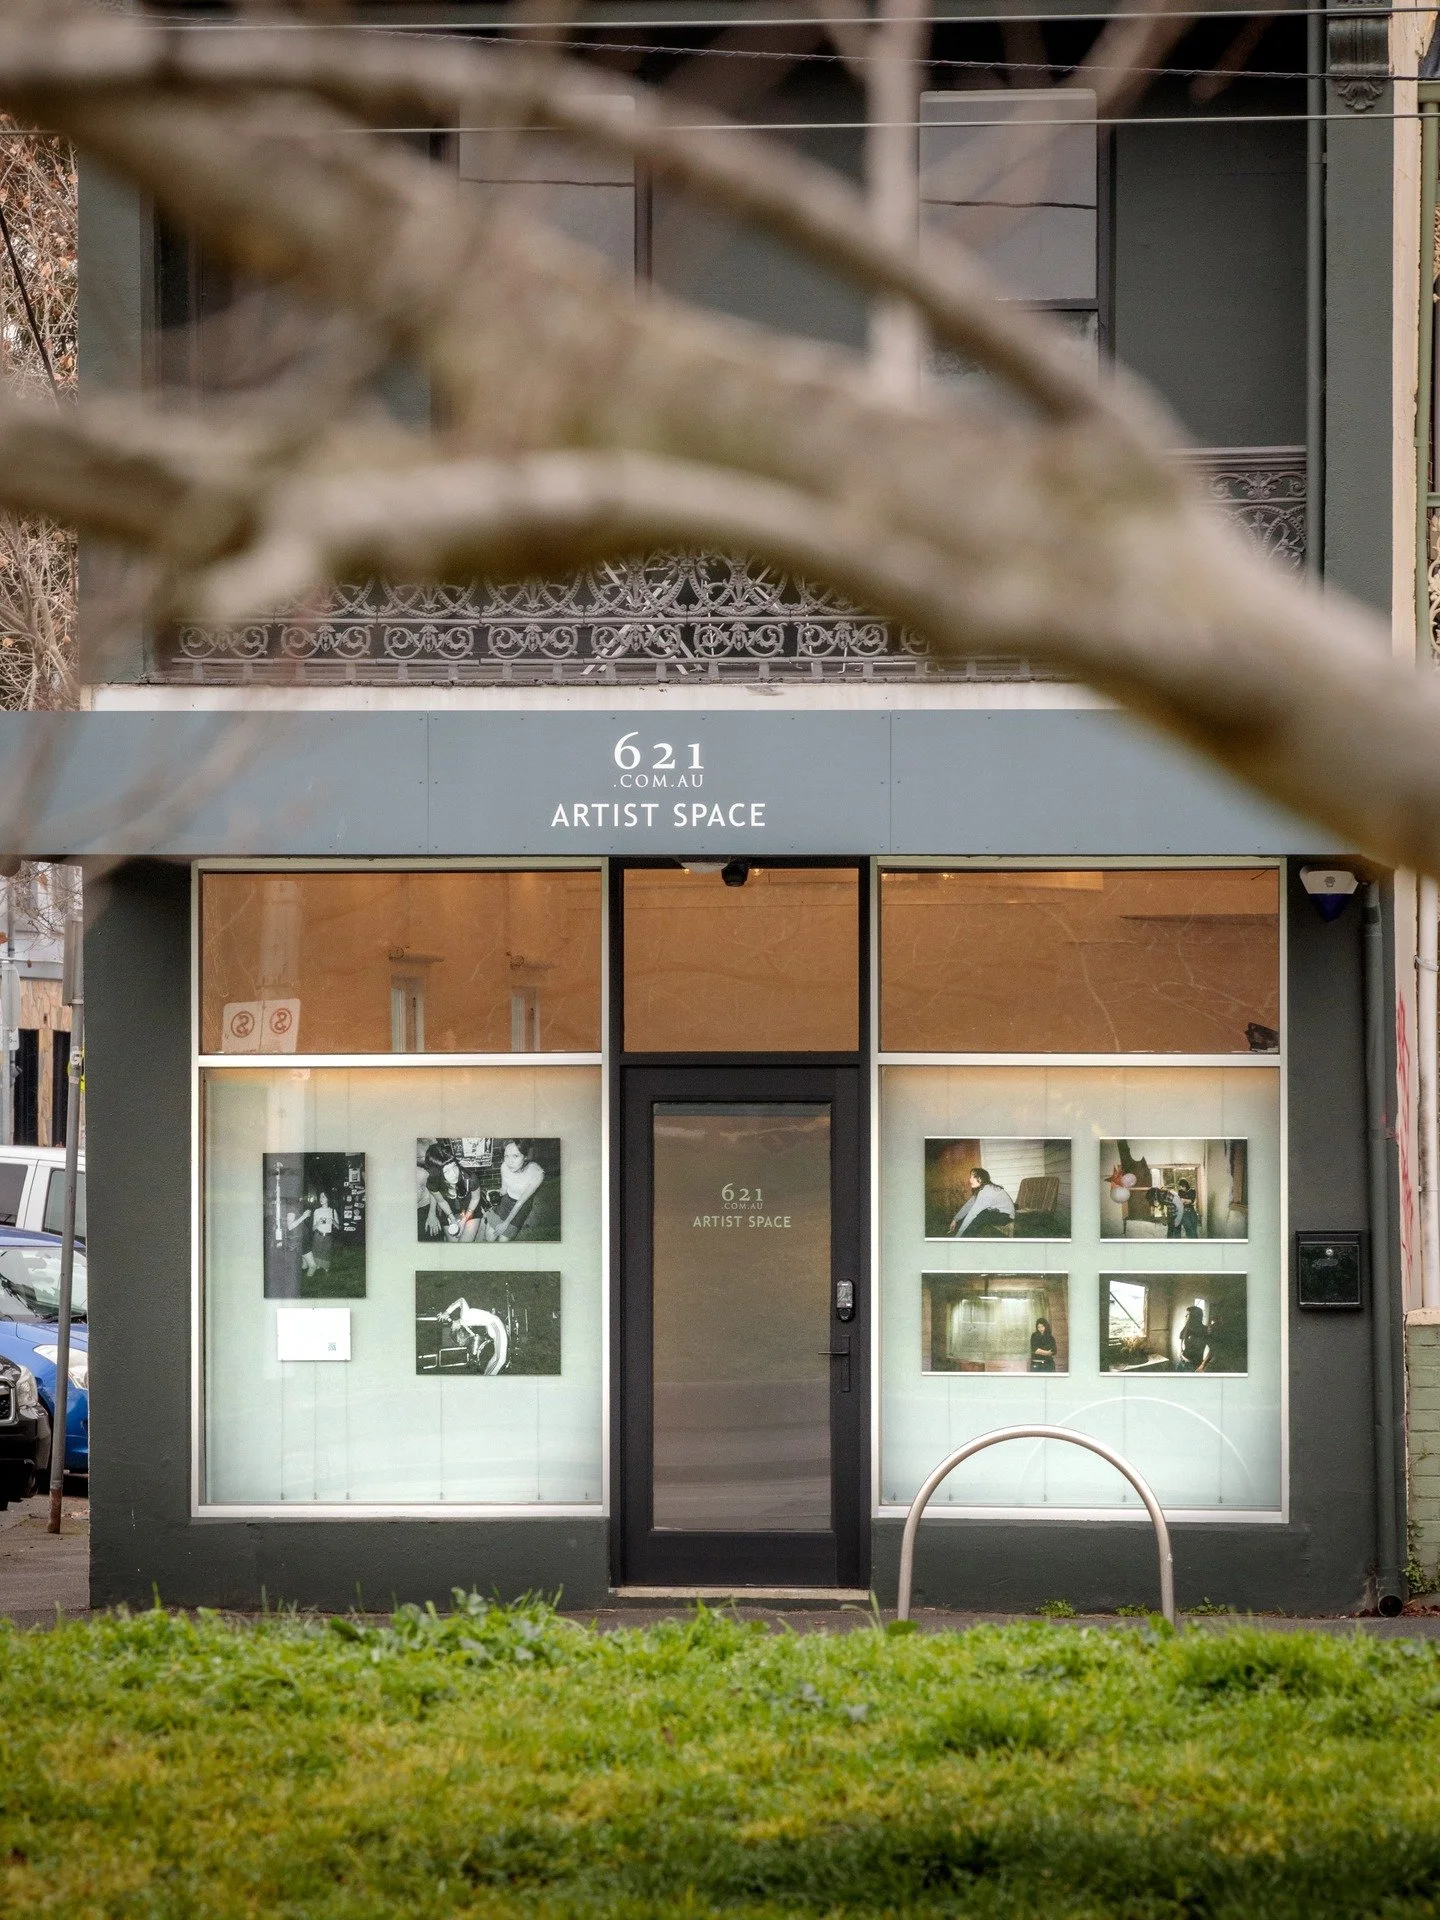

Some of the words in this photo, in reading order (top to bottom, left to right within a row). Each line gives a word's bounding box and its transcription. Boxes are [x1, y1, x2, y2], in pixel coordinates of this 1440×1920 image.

[614, 731, 705, 770] 621
[613, 774, 703, 788] .COM.AU
[551, 803, 659, 827] ARTIST
[673, 803, 766, 827] SPACE
[721, 1182, 763, 1202] 621
[721, 1202, 763, 1210] .COM.AU
[692, 1215, 742, 1228] ARTIST
[748, 1215, 791, 1228] SPACE
